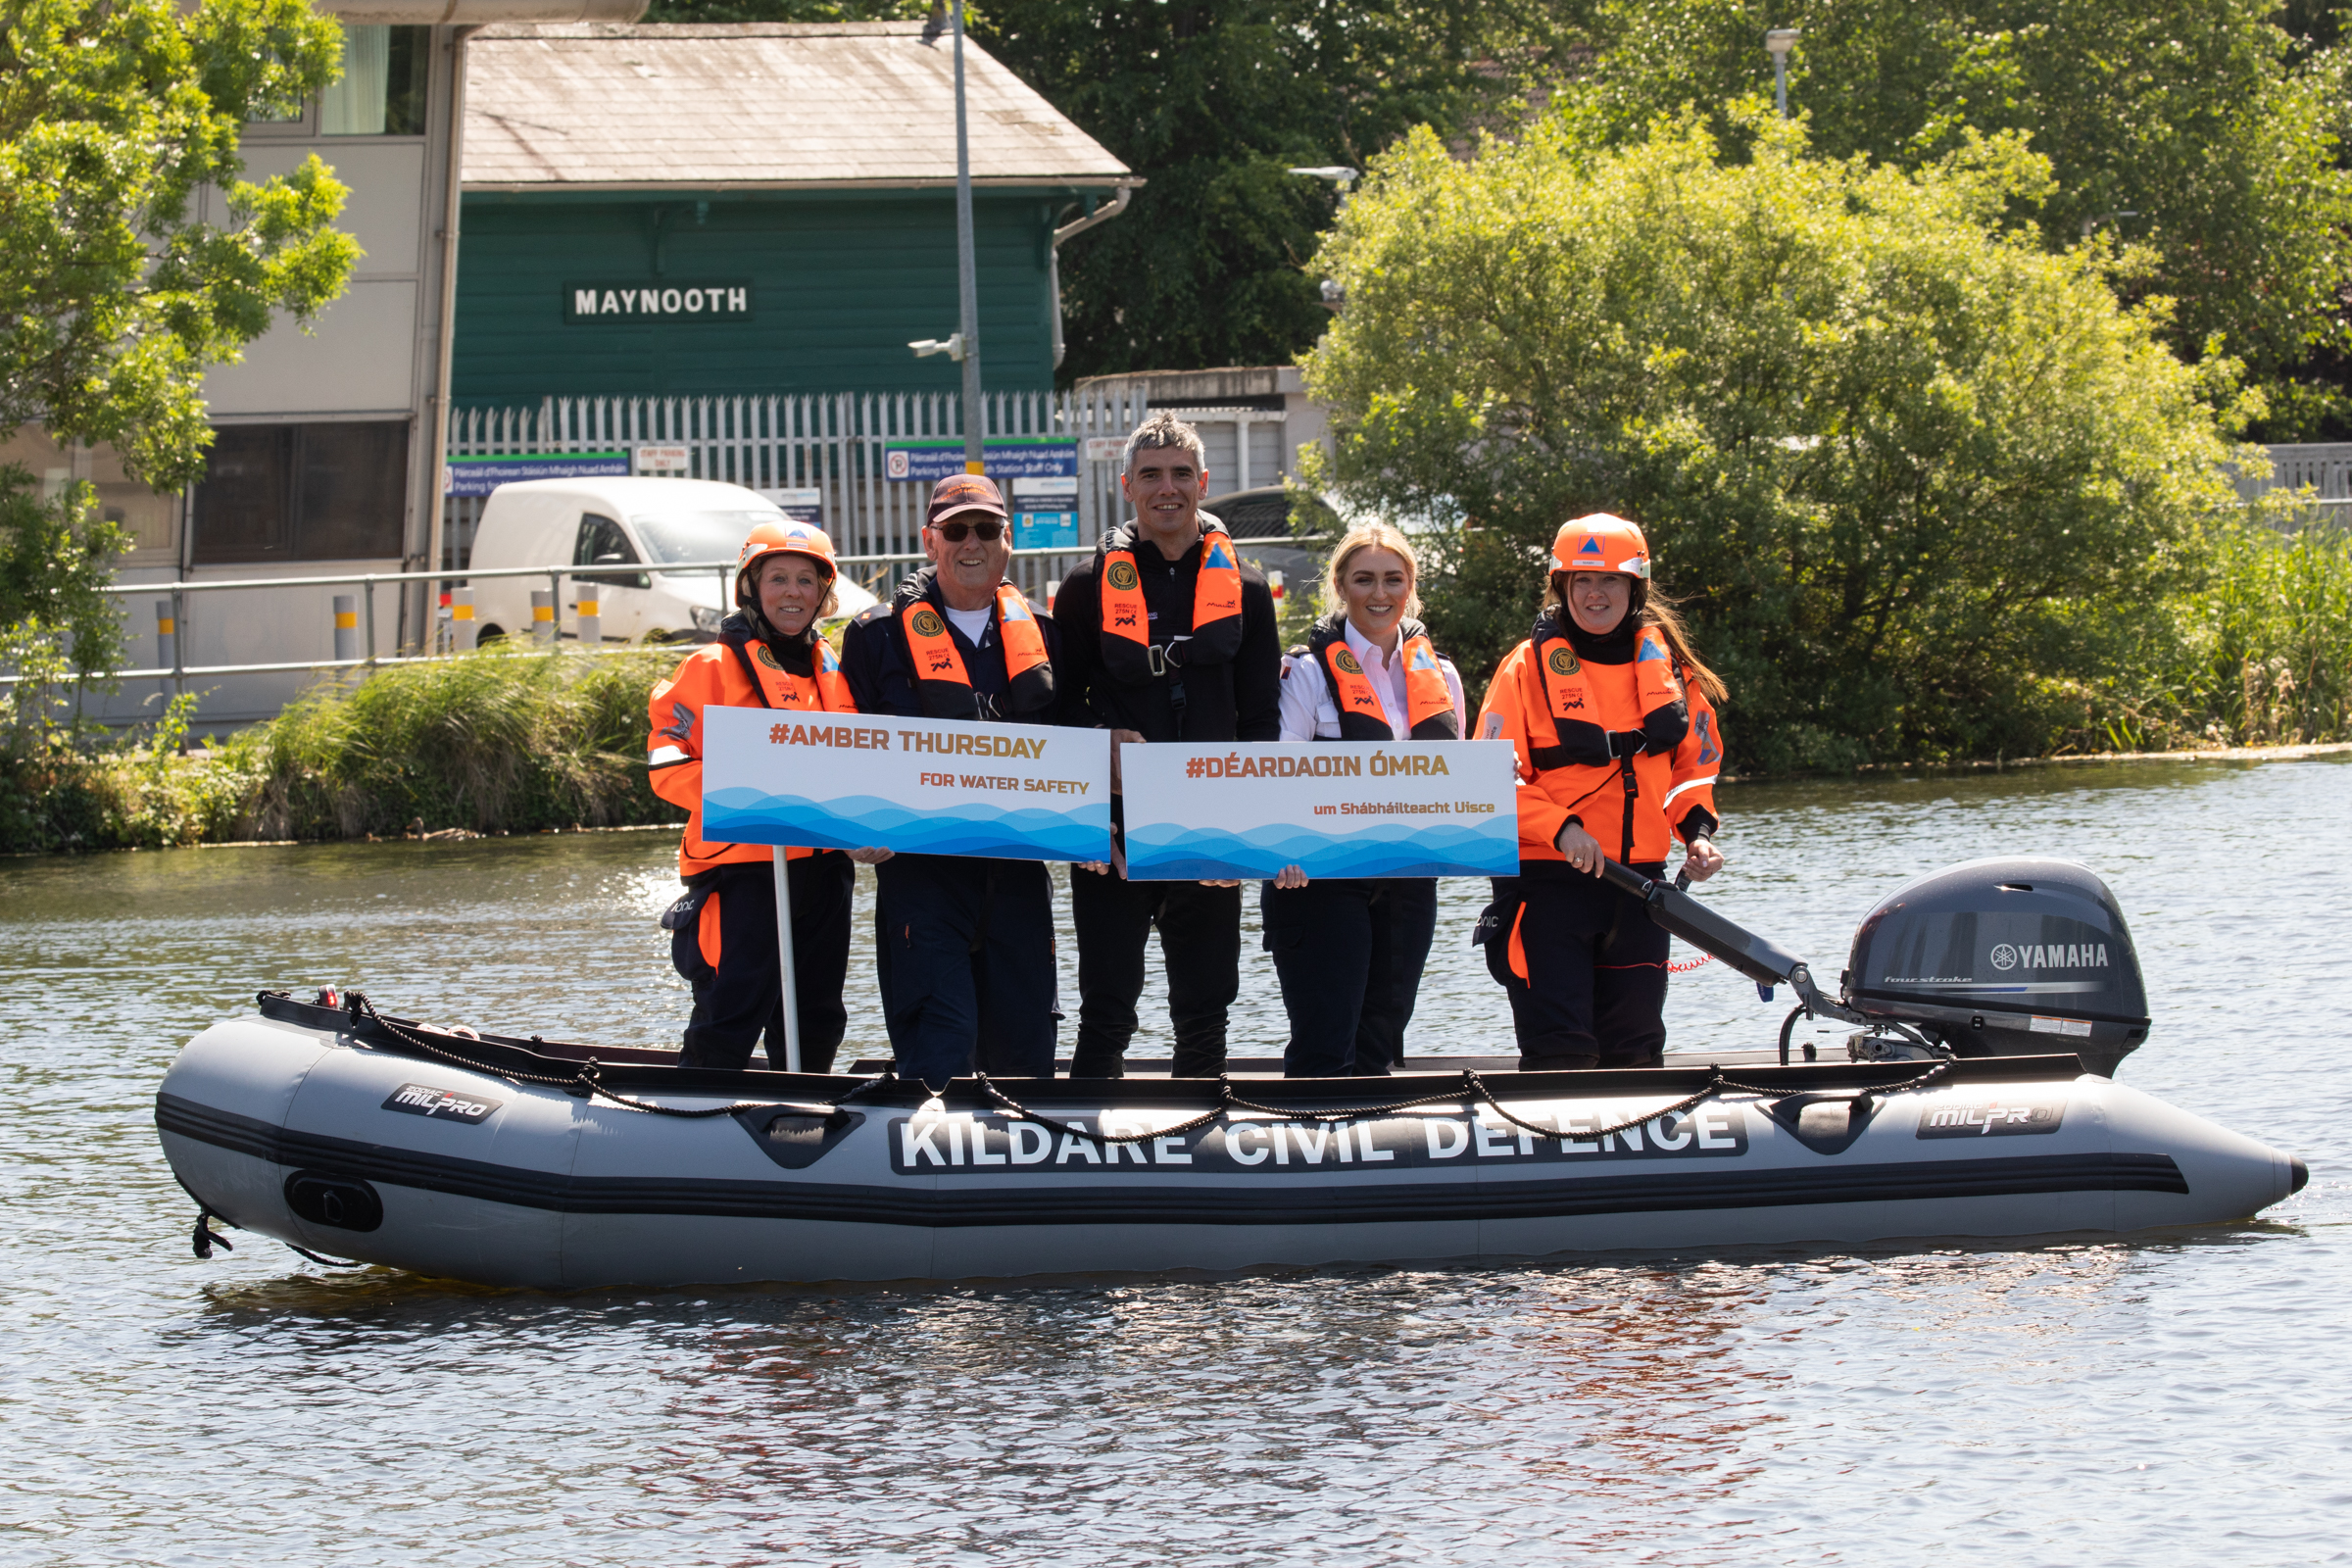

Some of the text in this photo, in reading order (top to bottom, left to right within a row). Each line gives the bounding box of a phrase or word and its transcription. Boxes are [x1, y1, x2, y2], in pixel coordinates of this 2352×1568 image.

[575, 288, 747, 315] MAYNOOTH
[909, 466, 940, 478] Parking
[941, 465, 953, 474] for
[996, 463, 1024, 473] Station
[1024, 462, 1044, 473] Staff
[1044, 462, 1063, 474] Only
[454, 481, 486, 493] Parking
[769, 723, 1048, 760] #AMBER THURSDAY
[1186, 750, 1450, 779] #DÉARDAOIN ÓMRA
[920, 772, 1090, 795] FOR WATER SAFETY
[1314, 802, 1495, 815] um Shábháilteacht Uisce
[2018, 944, 2109, 968] YAMAHA
[406, 1085, 444, 1098] ZODIAC
[901, 1106, 1736, 1167] KILDARE CIVIL DEFENCE
